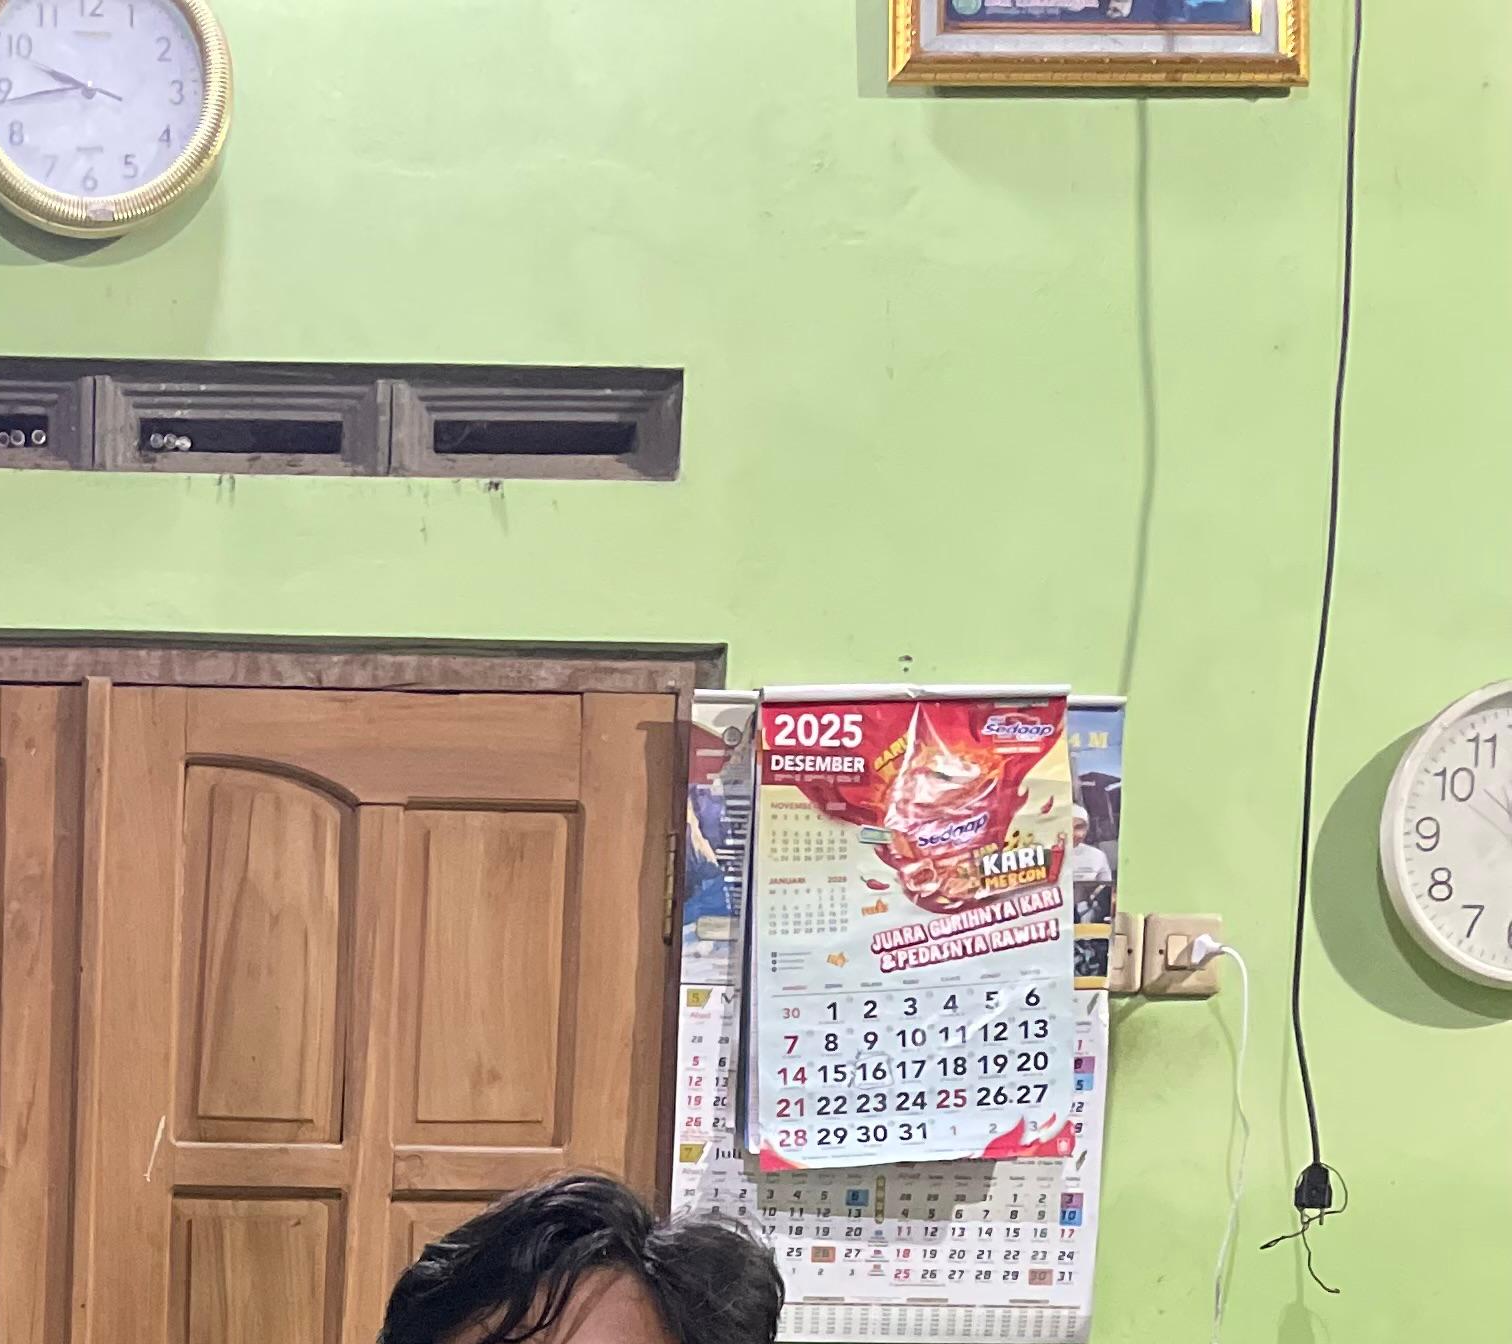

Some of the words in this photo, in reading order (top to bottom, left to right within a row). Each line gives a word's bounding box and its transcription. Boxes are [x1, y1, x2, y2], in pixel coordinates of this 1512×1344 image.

[38, 5, 58, 27] 11
[80, 0, 104, 17] 12
[127, 4, 134, 28] 1
[7, 33, 33, 59] 10
[155, 36, 172, 62] 2
[169, 79, 185, 105] 3
[8, 120, 24, 146] 8
[158, 124, 171, 148] 4
[43, 155, 58, 180] 7
[122, 154, 137, 179] 5
[81, 167, 98, 192] 6
[774, 713, 863, 748] 2025
[1466, 733, 1497, 769] 11
[771, 755, 865, 773] DESEMBER
[1433, 767, 1475, 802] 10
[1415, 816, 1440, 852] 9
[982, 845, 1045, 877] KARI
[985, 866, 1047, 889] MERCON
[1428, 867, 1453, 901] 8
[872, 924, 927, 953] JUARA
[929, 900, 1018, 939] GURIHNYA
[1020, 887, 1062, 915] KARI
[1461, 905, 1485, 938] 7
[782, 1008, 800, 1019] 30
[827, 1002, 838, 1020] 1
[863, 1000, 877, 1019] 2
[903, 997, 917, 1016] 3
[943, 994, 958, 1012] 4
[986, 991, 999, 1009] 5
[1025, 987, 1040, 1006] 6
[784, 1035, 799, 1054] 7
[824, 1033, 838, 1051] 8
[863, 1031, 878, 1050] 9
[897, 1028, 927, 1047] 10
[938, 1025, 967, 1043] 11
[978, 1022, 1008, 1042] 12
[1018, 1019, 1049, 1039] 13
[691, 1056, 700, 1066] 5
[719, 1057, 726, 1067] 6
[777, 1066, 807, 1086] 14
[817, 1064, 847, 1083] 15
[857, 1062, 887, 1081] 16
[896, 1059, 926, 1079] 17
[936, 1056, 967, 1077] 18
[977, 1054, 1008, 1074] 19
[1016, 1051, 1048, 1072] 20
[688, 1076, 703, 1087] 12
[715, 1077, 729, 1087] 13
[687, 1096, 702, 1106] 19
[776, 1098, 806, 1118] 21
[816, 1095, 848, 1116] 22
[856, 1093, 887, 1113] 23
[895, 1090, 927, 1111] 24
[936, 1088, 967, 1109] 25
[1016, 1083, 1049, 1104] 27
[685, 1117, 701, 1127] 26
[778, 1129, 807, 1148] 28
[817, 1127, 848, 1146] 29
[856, 1124, 888, 1144] 30
[898, 1121, 928, 1140] 31
[950, 1125, 957, 1136] 1
[989, 1124, 997, 1134] 2
[1029, 1120, 1038, 1132] 3
[715, 1147, 742, 1160] Juli
[714, 1188, 719, 1197] 1
[739, 1189, 747, 1198] 2
[766, 1189, 774, 1199] 3
[793, 1190, 802, 1199] 4
[820, 1191, 828, 1200] 5
[1037, 1194, 1046, 1203] 2
[1066, 1194, 1074, 1203] 3
[762, 1207, 777, 1216] 10
[789, 1207, 804, 1217] 11
[816, 1208, 831, 1217] 12
[847, 1208, 862, 1218] 13
[901, 1209, 909, 1218] 4
[928, 1209, 935, 1218] 5
[955, 1209, 964, 1219] 6
[982, 1209, 990, 1219] 7
[1010, 1209, 1018, 1219] 8
[1037, 1210, 1046, 1220] 9
[1061, 1210, 1076, 1220] 10
[761, 1225, 776, 1235] 17
[788, 1226, 803, 1236] 18
[815, 1226, 830, 1236] 19
[845, 1227, 862, 1237] 20
[897, 1226, 912, 1236] 11
[924, 1227, 938, 1237] 12
[951, 1227, 965, 1237] 13
[978, 1228, 993, 1237] 14
[1005, 1228, 1020, 1238] 15
[1033, 1228, 1048, 1238] 16
[1060, 1229, 1075, 1239] 17
[786, 1247, 802, 1257] 25
[844, 1249, 861, 1258] 27
[895, 1248, 910, 1258] 18
[922, 1249, 937, 1259] 19
[949, 1249, 966, 1259] 20
[976, 1250, 992, 1260] 21
[1003, 1250, 1020, 1260] 22
[1031, 1250, 1048, 1261] 23
[1058, 1251, 1074, 1261] 24
[894, 1269, 910, 1279] 25
[921, 1269, 937, 1279] 26
[948, 1270, 964, 1280] 27
[975, 1270, 991, 1280] 28
[1002, 1270, 1019, 1280] 29
[1057, 1271, 1073, 1281] 31
